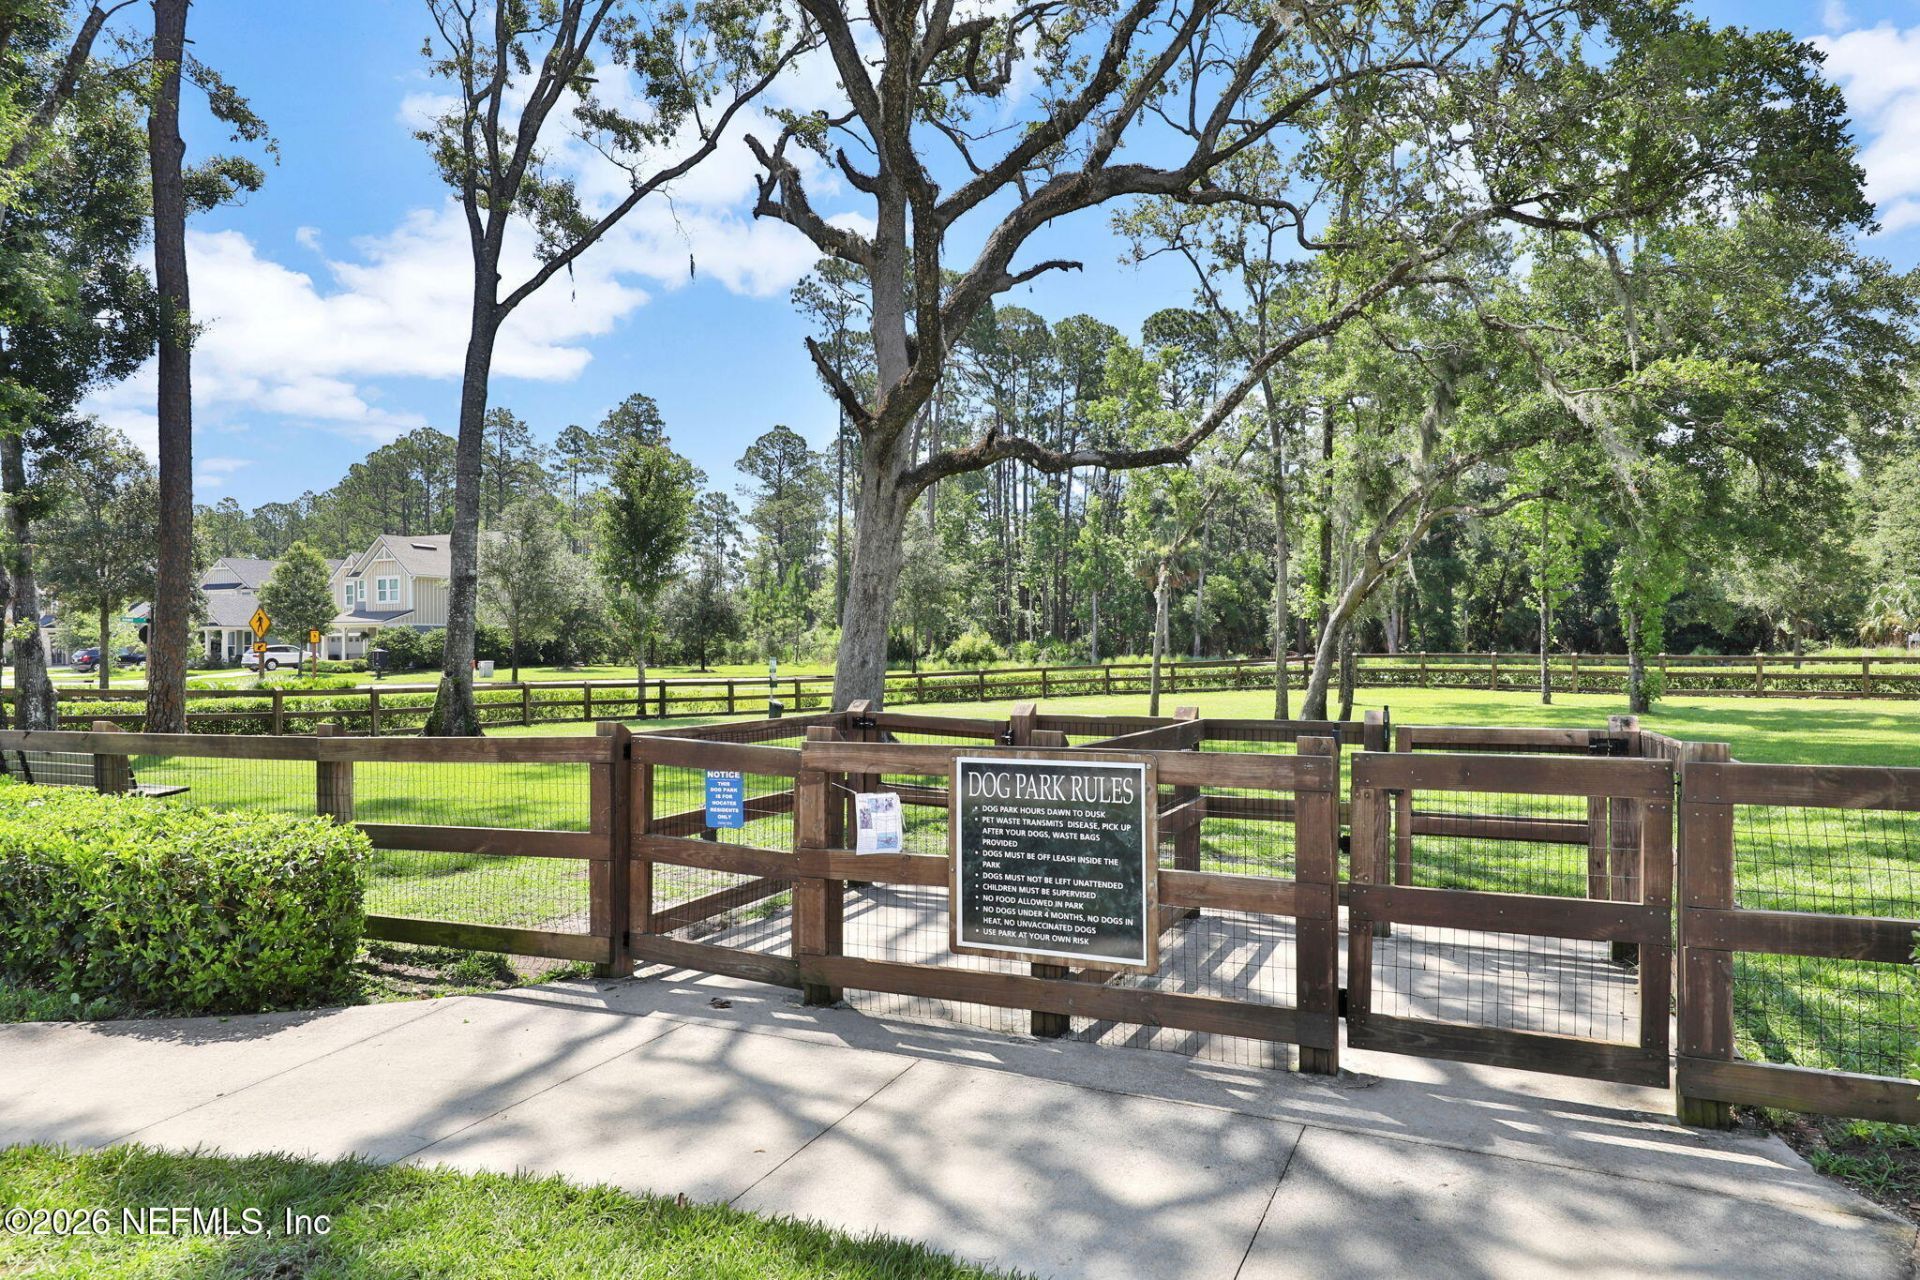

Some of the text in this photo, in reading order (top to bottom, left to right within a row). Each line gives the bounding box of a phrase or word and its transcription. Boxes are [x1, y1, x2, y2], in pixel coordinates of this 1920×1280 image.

[968, 772, 1134, 804] DOG PARK RULES
[1020, 807, 1045, 815] HOURS
[1047, 809, 1071, 817] DAWN
[996, 817, 1020, 825] WASTE
[1023, 819, 1063, 827] TRANSMITS
[1068, 821, 1100, 830] DISEASE,
[982, 839, 1017, 847] PROVIDED
[1028, 831, 1050, 839] DOGS,
[1080, 833, 1100, 841] BAGS
[982, 850, 1002, 858] DOGS
[1004, 851, 1025, 859] MUST
[1038, 853, 1051, 861] OFF
[1053, 854, 1076, 863] LEASH
[1078, 856, 1102, 865] INSIDE
[983, 872, 1003, 880] DOGS
[1005, 874, 1025, 882] MUST
[1027, 875, 1042, 883] NOT
[1073, 879, 1123, 889] UNATTENDED
[983, 883, 1017, 892] CHILDREN
[1019, 886, 1039, 894] MUST
[1052, 889, 1096, 899] SUPERVISED
[996, 896, 1016, 904] FOOD
[1018, 897, 1053, 907] ALLOWED
[1065, 901, 1084, 909] PARK
[996, 907, 1016, 915] DOGS
[1018, 909, 1043, 917] UNDER
[1051, 911, 1086, 922] MONTHS,
[1101, 916, 1123, 925] DOGS
[983, 917, 1002, 925] HEAT,
[1017, 920, 1073, 932] UNVACCINATED
[1075, 925, 1096, 934] DOGS
[983, 928, 997, 936] USE
[998, 929, 1016, 937] PARK
[1029, 932, 1050, 941] YOUR
[1052, 935, 1071, 943] OWN
[1073, 937, 1089, 945] RISK
